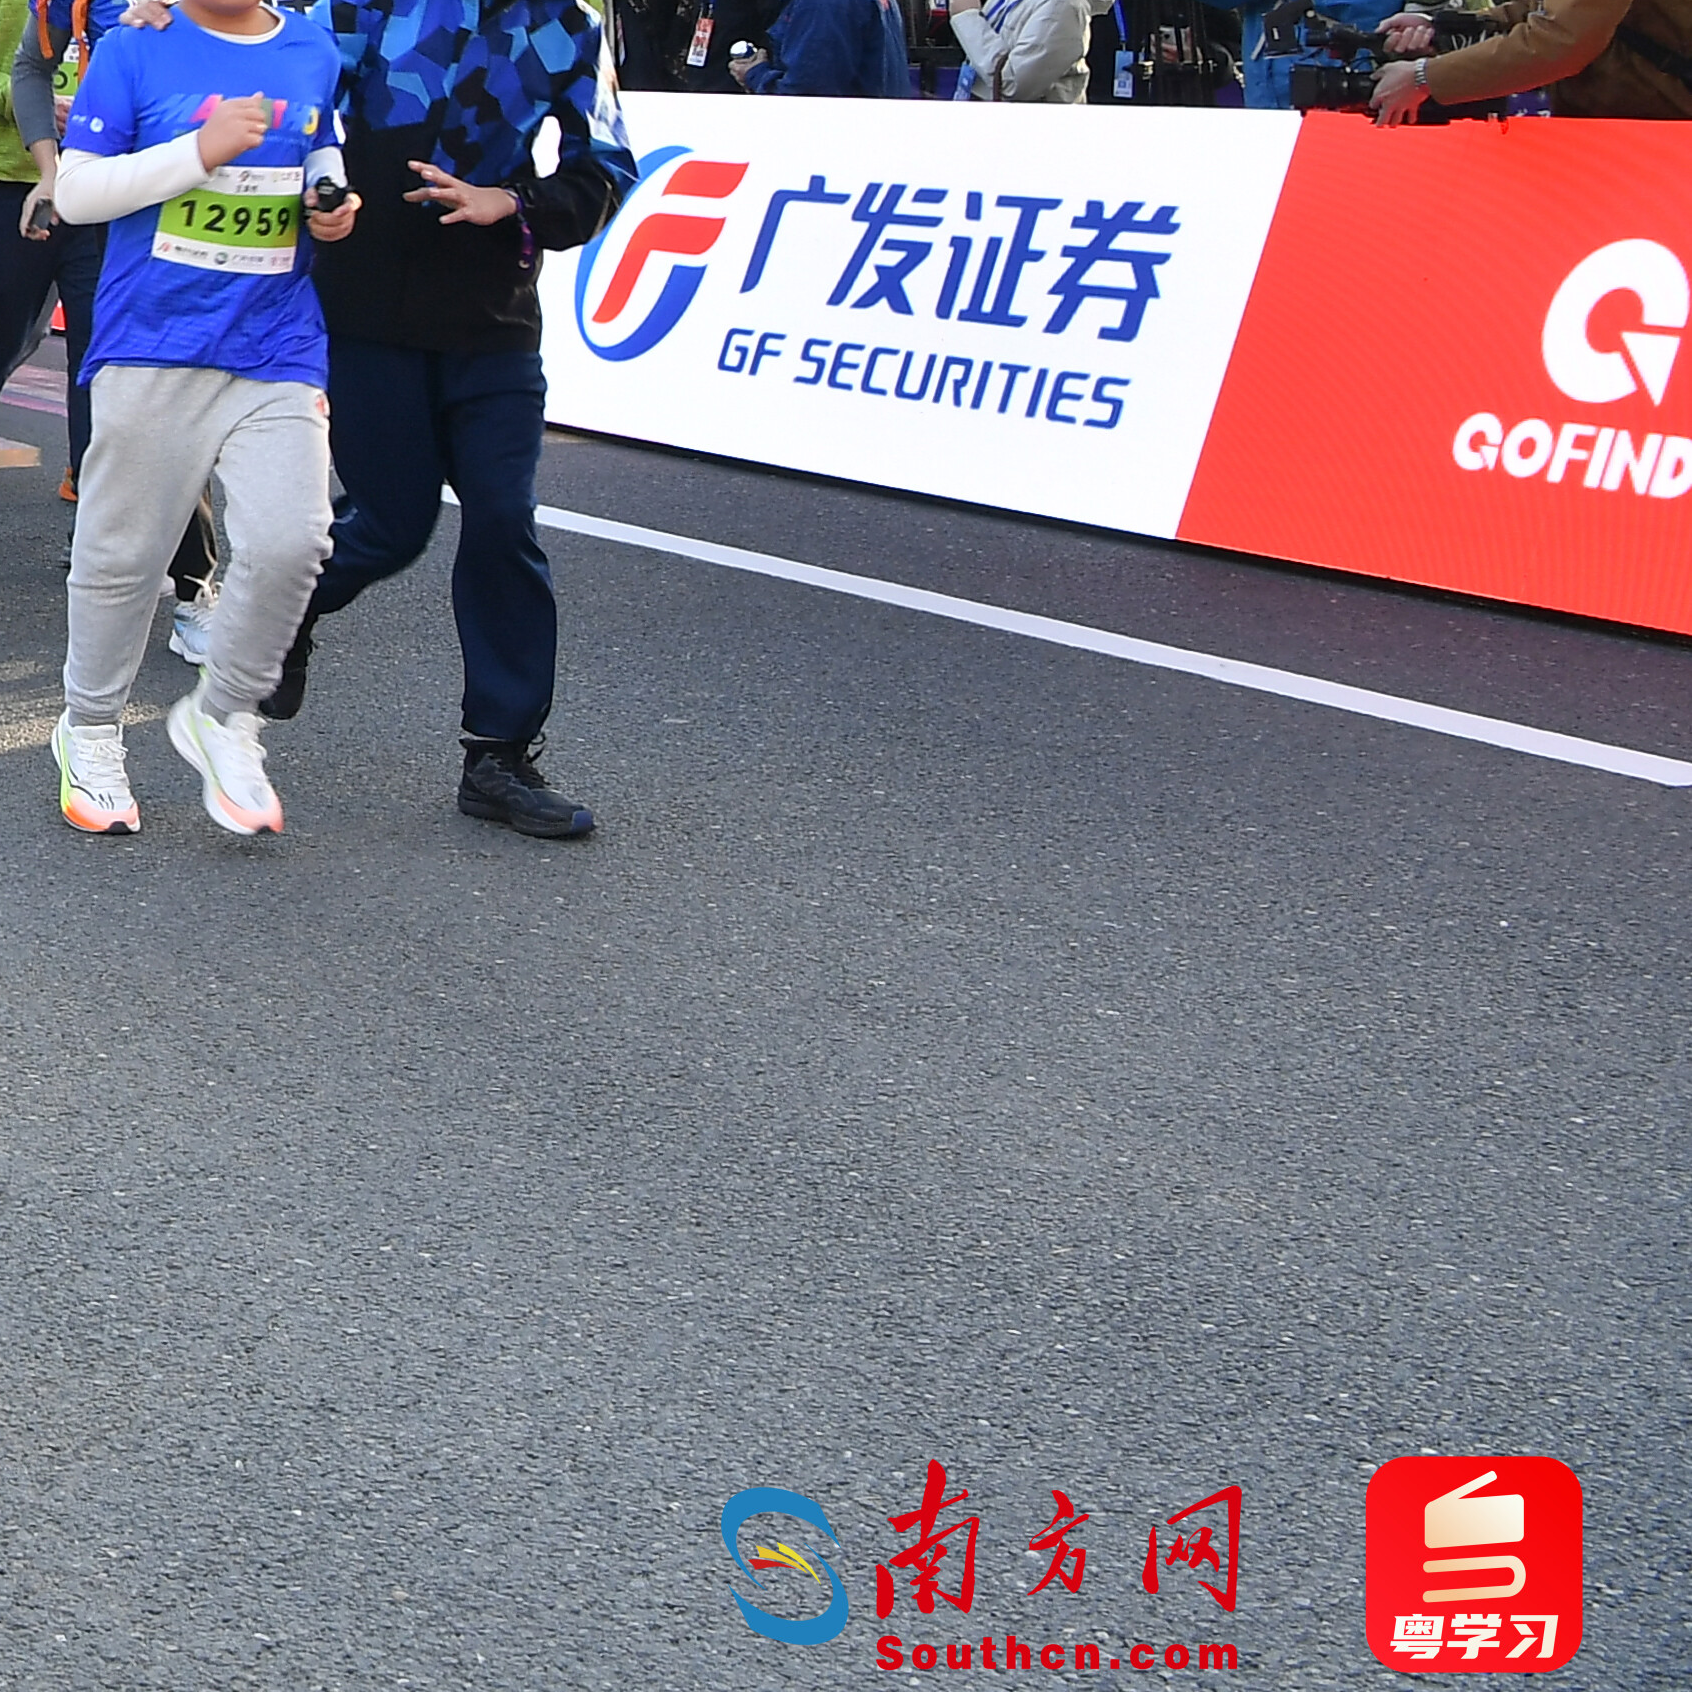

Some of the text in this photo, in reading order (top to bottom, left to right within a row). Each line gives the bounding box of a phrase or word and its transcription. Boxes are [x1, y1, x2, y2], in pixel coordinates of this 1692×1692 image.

[179, 199, 291, 237] 12959
[738, 174, 1181, 343] 广发证券
[717, 327, 1132, 431] GF SECURITIES
